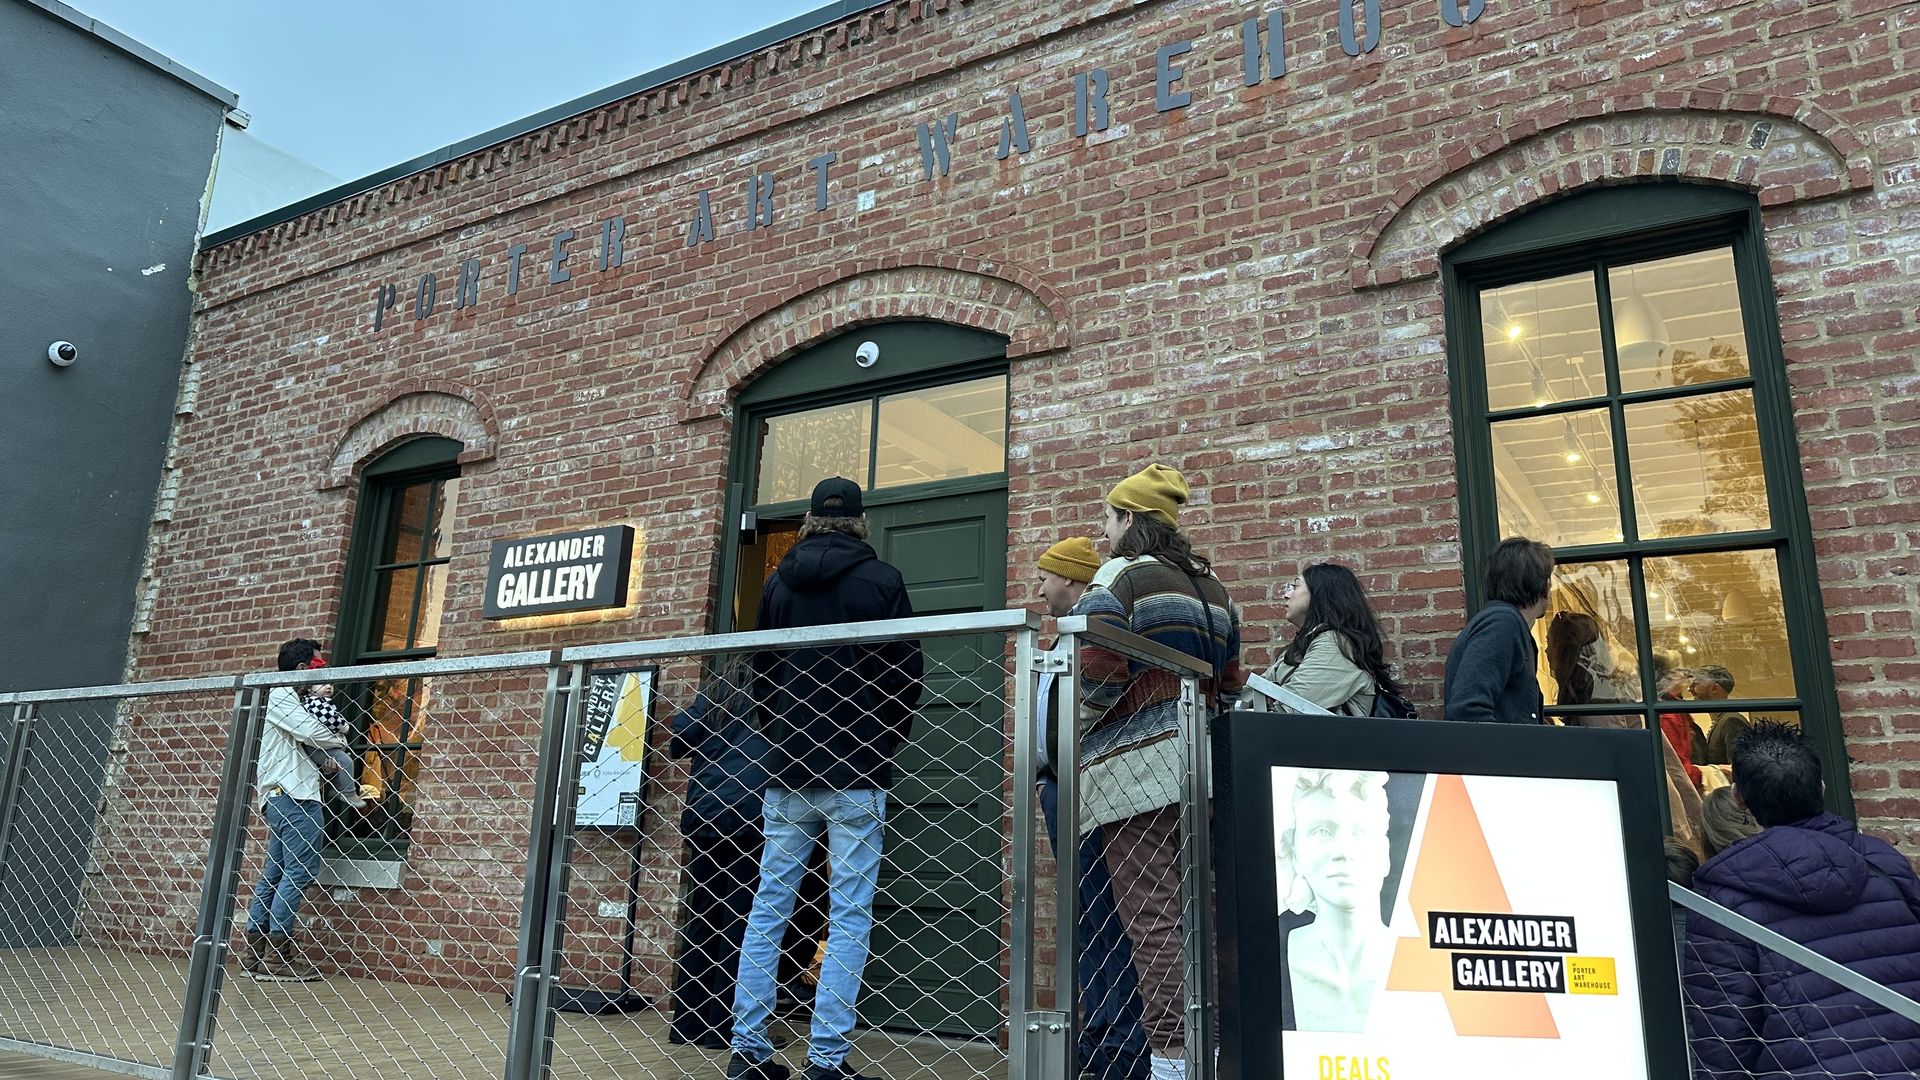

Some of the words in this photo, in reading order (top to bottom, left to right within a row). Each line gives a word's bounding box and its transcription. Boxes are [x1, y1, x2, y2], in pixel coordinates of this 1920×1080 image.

[374, 215, 624, 332] PORTER
[687, 152, 836, 248] ART
[503, 535, 605, 568] ALEXANDER
[496, 563, 603, 609] GALLERY
[583, 677, 618, 755] GALLERY
[1435, 917, 1572, 948] ALEXANDER
[1456, 958, 1560, 988] GALLERY
[1574, 981, 1611, 989] WAREHOUSE
[1318, 1055, 1391, 1080] DEALS
